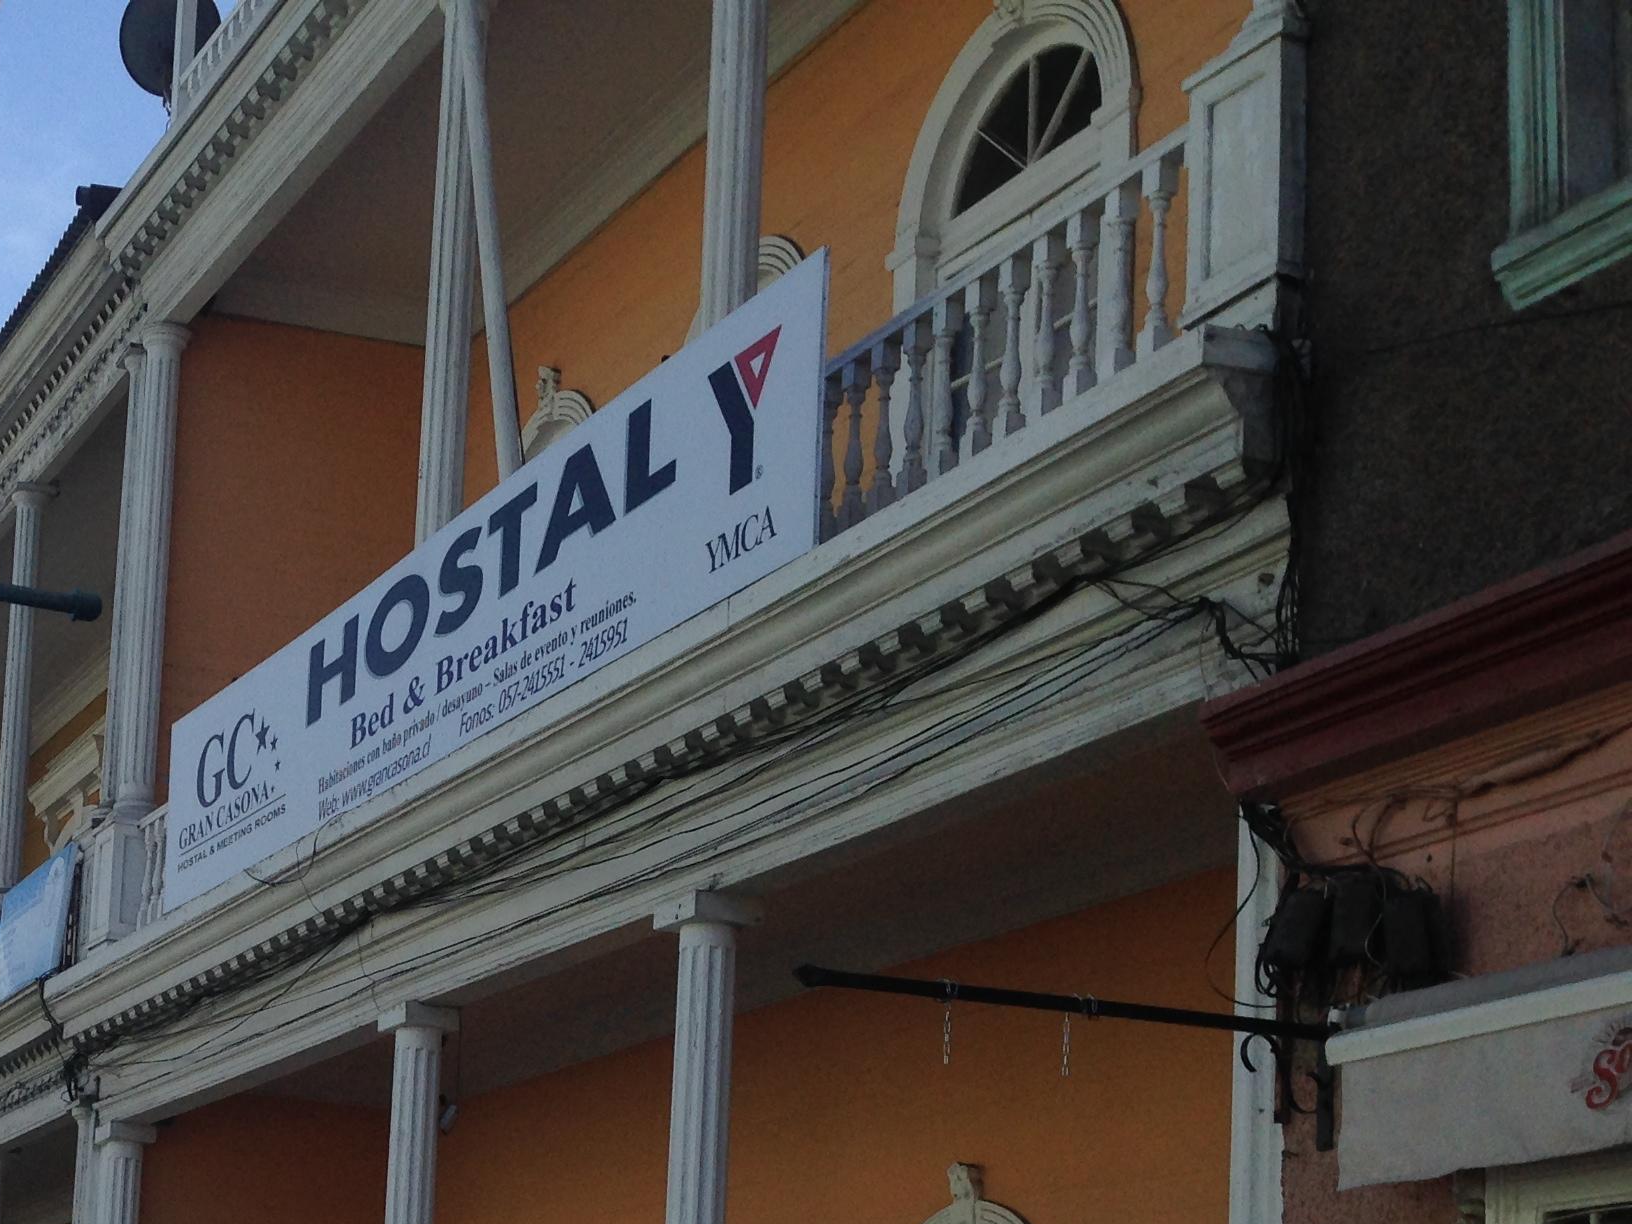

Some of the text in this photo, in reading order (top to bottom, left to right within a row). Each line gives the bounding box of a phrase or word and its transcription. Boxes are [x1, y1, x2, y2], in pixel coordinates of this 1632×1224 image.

[305, 399, 676, 728] HOSTAL
[705, 505, 777, 573] YMCA
[318, 755, 365, 794] Habitaciones
[367, 746, 380, 763] con
[382, 732, 402, 754] baño
[403, 710, 434, 747] privado
[441, 682, 483, 718] desayuno
[493, 661, 518, 682] Salas
[519, 650, 533, 670] de
[534, 629, 568, 662] evento
[569, 624, 577, 645] y
[580, 591, 637, 634] reuniones.
[349, 577, 576, 750] Bed & Breakfast
[459, 703, 496, 737] Fonos:
[498, 653, 565, 714] 057-2415551
[578, 617, 628, 669] 2415951
[196, 707, 256, 808] GC
[318, 733, 432, 821] Web: www.grancasona.cl
[177, 849, 208, 873] HOSTAL
[216, 823, 252, 851] MEETING
[254, 803, 287, 830] ROOMS
[178, 779, 269, 850] GRAN CASONA
